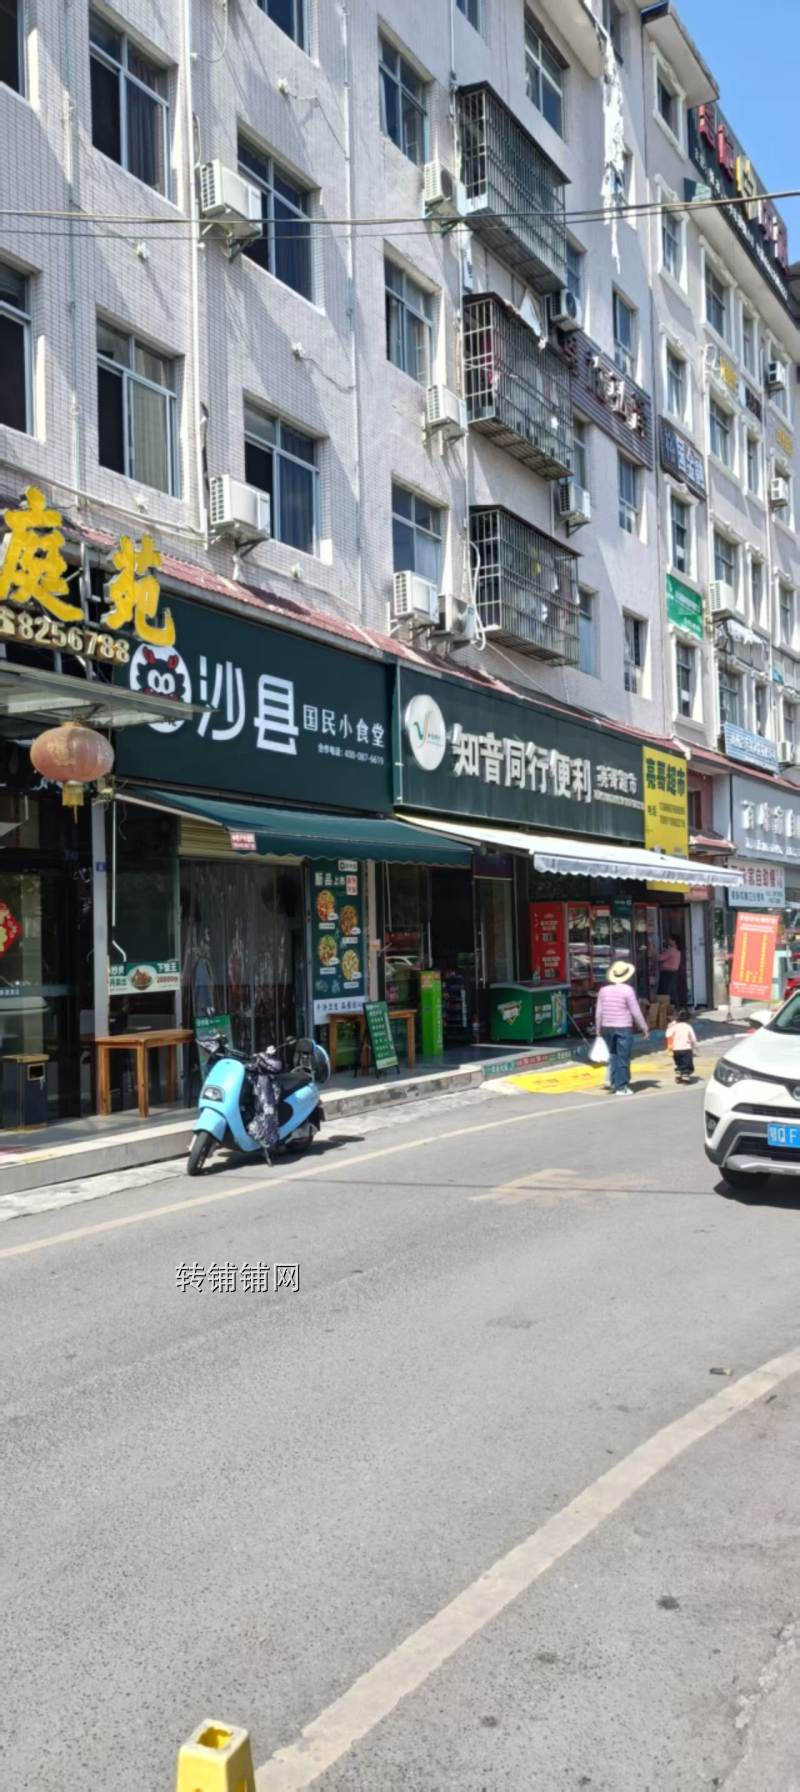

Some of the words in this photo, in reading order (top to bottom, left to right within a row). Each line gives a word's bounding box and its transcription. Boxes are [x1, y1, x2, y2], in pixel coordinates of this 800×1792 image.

[17, 611, 131, 663] 8256788
[197, 654, 299, 756] 沙县
[303, 704, 385, 748] 国民小食堂
[452, 723, 592, 803] 知音同行便利
